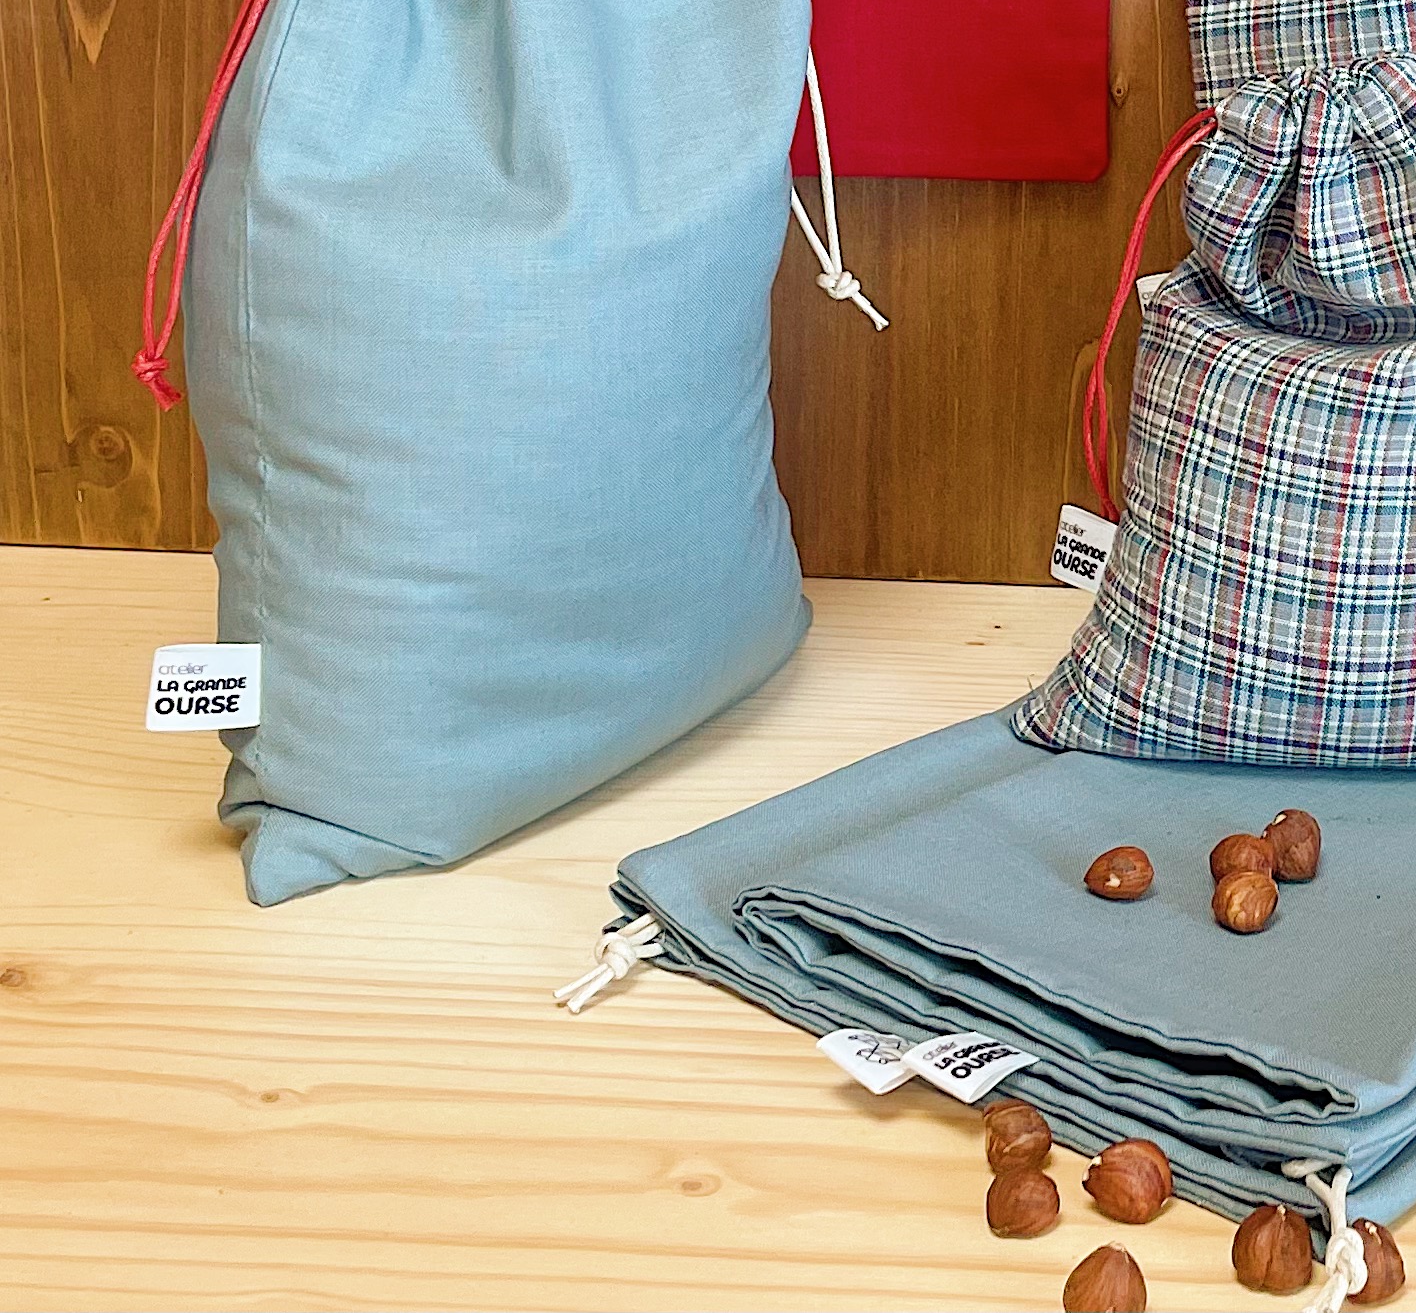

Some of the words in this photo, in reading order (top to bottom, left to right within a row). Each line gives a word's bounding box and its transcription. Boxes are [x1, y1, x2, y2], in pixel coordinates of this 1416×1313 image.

[1068, 538, 1107, 563] GRANDE
[1053, 548, 1098, 580] OURSE
[158, 662, 208, 675] atelier
[157, 679, 179, 692] LA
[183, 676, 247, 694] GRANDE
[154, 694, 240, 715] OURSE
